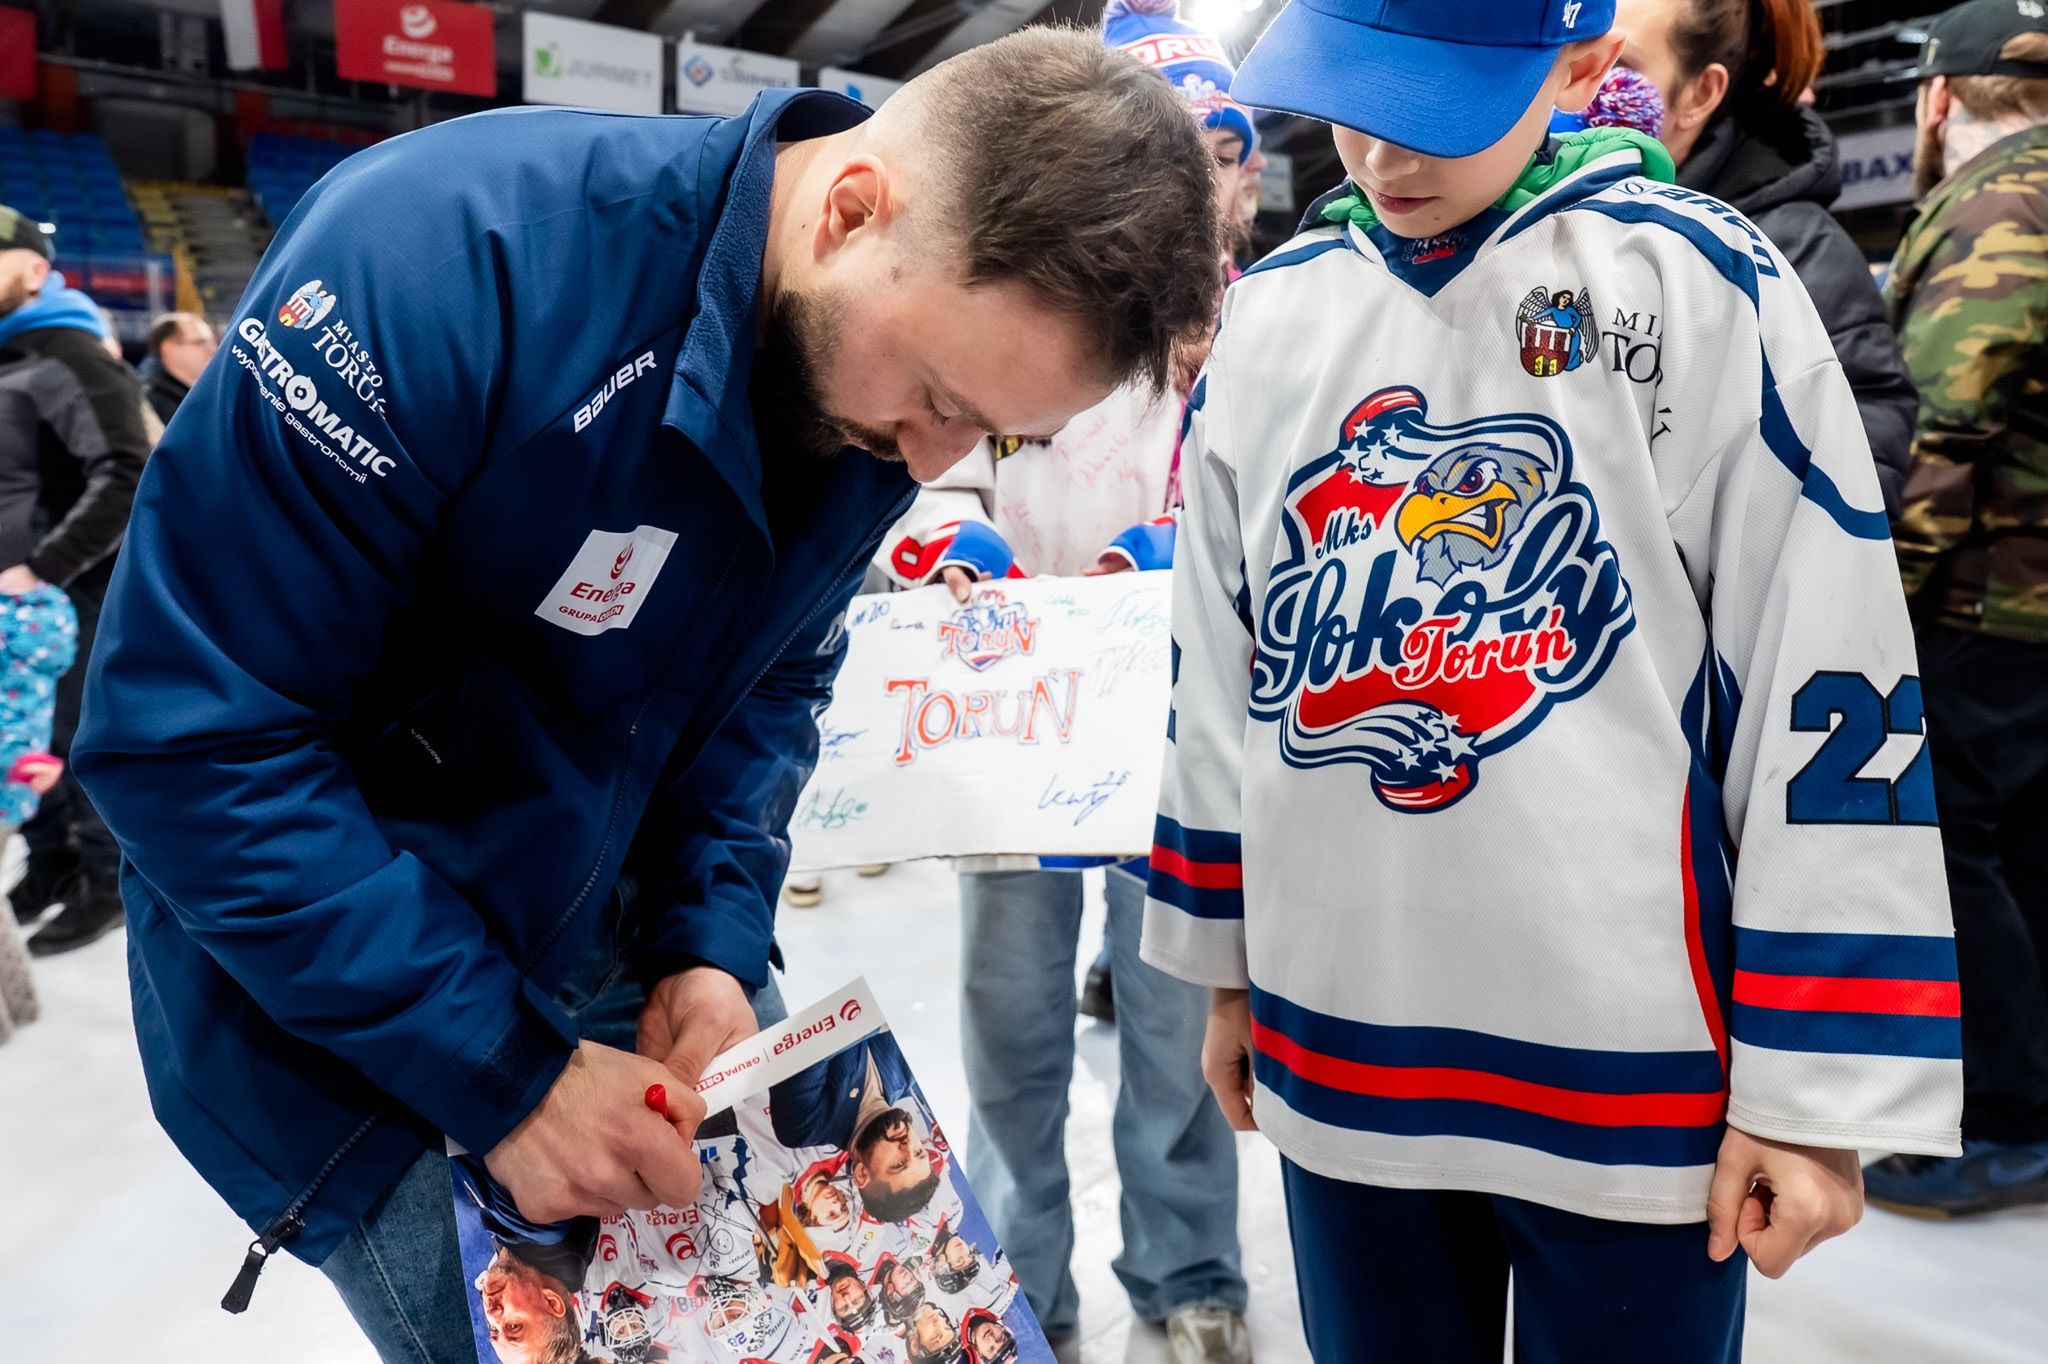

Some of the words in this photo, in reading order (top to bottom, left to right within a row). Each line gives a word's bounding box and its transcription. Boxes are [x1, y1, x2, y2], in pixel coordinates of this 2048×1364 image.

[332, 318, 384, 388] MIASTO
[284, 412, 367, 484] gastronomii
[1315, 511, 1372, 559] Mks
[558, 605, 598, 623] GRUPA
[1395, 606, 1573, 684] Toruń
[773, 1014, 836, 1056] Energa
[724, 1056, 760, 1077] GRUPA
